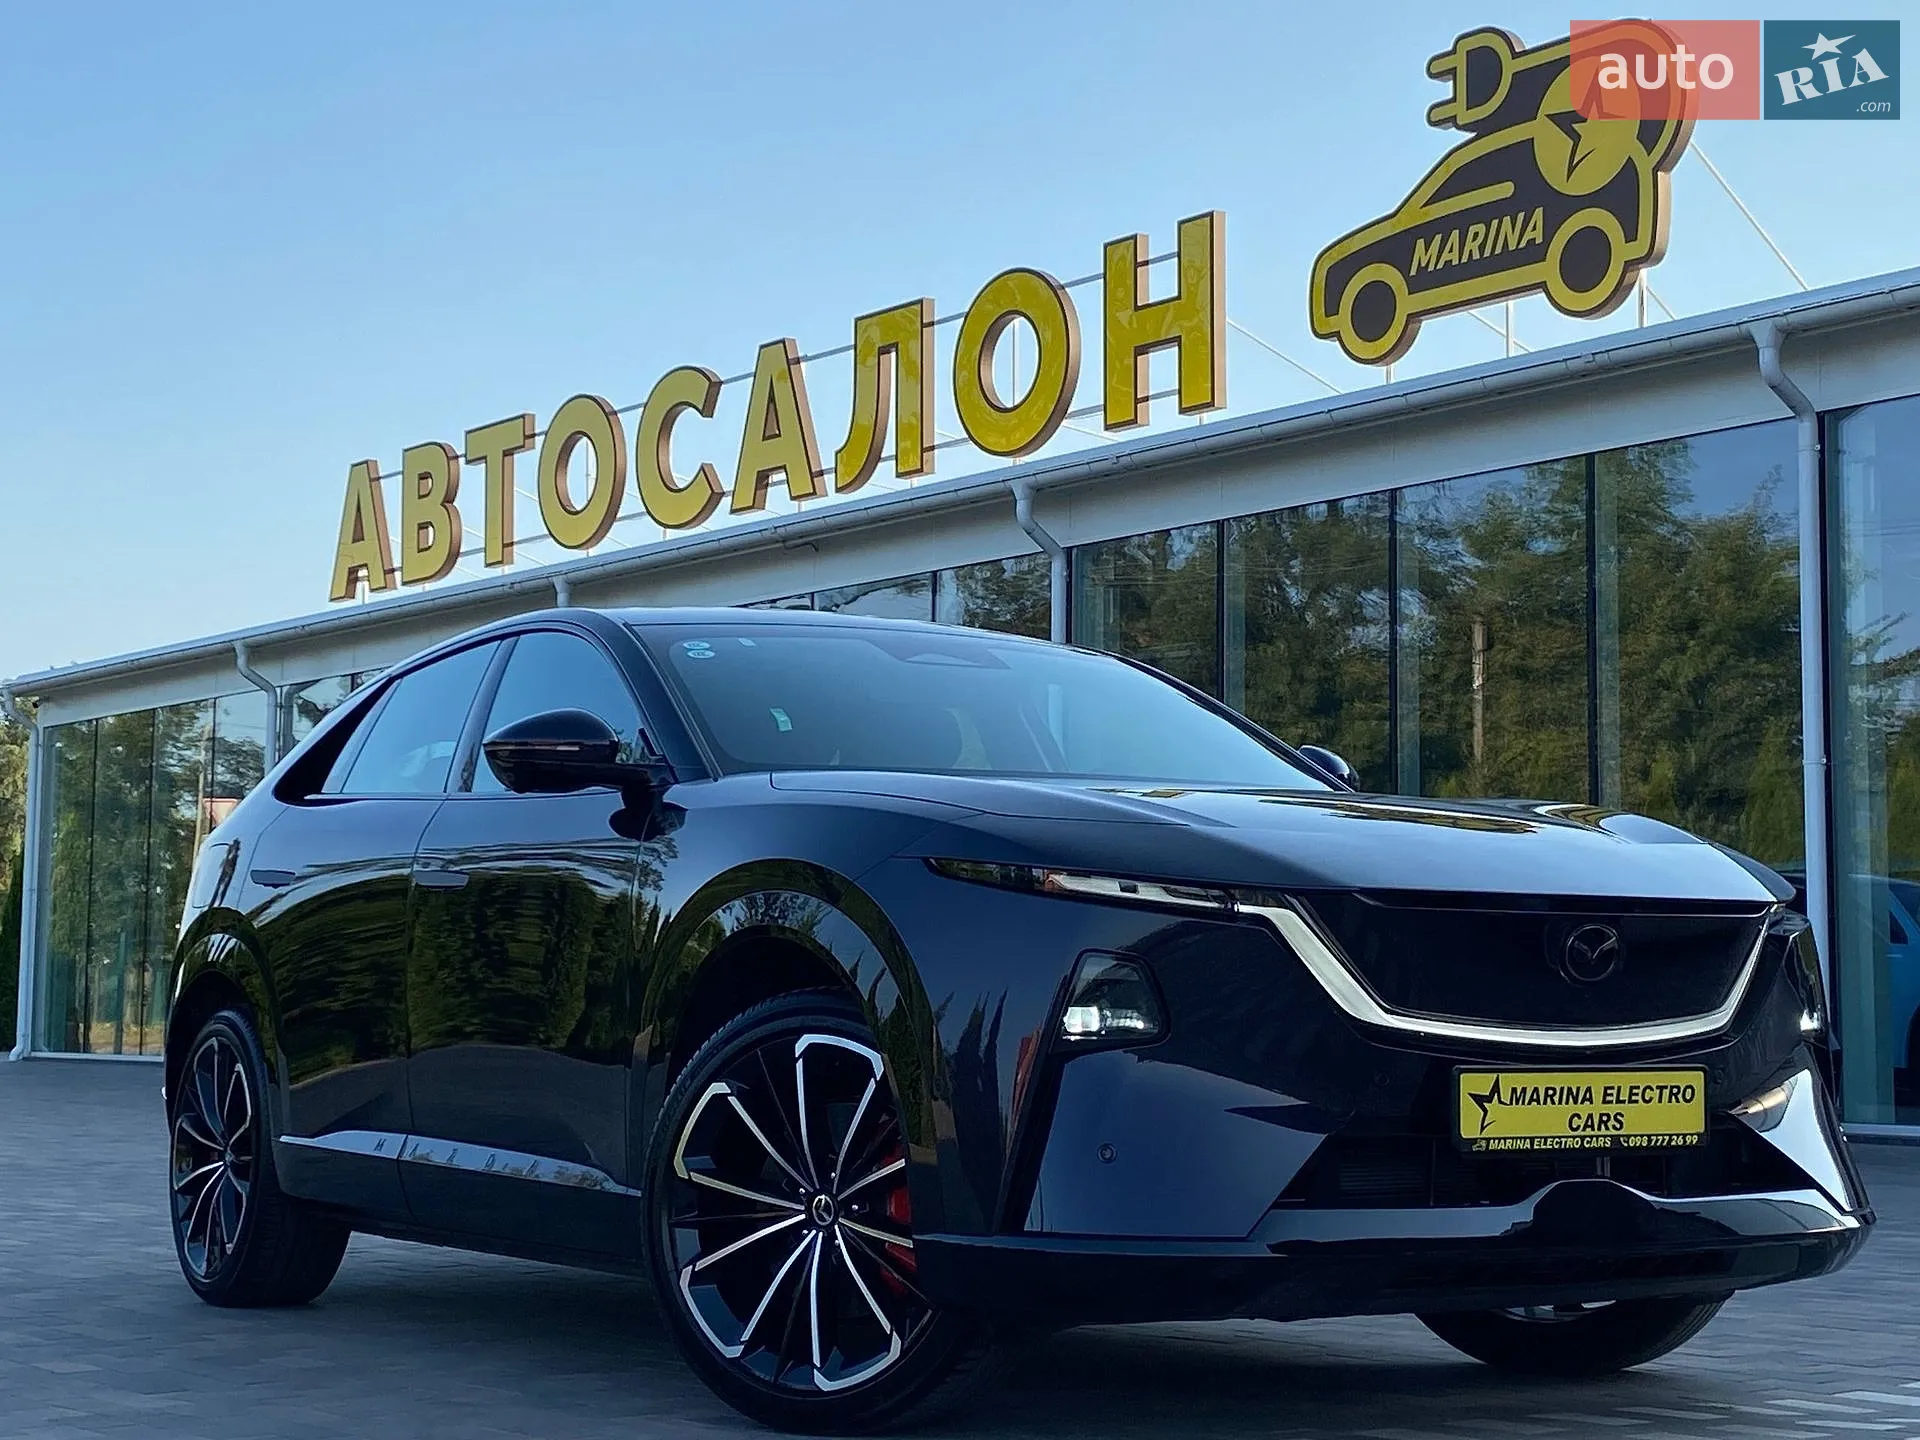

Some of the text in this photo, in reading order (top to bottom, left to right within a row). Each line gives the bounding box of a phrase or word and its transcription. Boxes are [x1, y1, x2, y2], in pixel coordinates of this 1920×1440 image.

[1409, 206, 1545, 277] MARINA
[330, 210, 1226, 601] АВТОСАЛОН
[1509, 1085, 1696, 1106] MARINA ELECTRO
[1568, 1112, 1625, 1132] CARS
[1488, 1134, 1698, 1150] MARINA ELECTRO CARS 098 777 26 99
